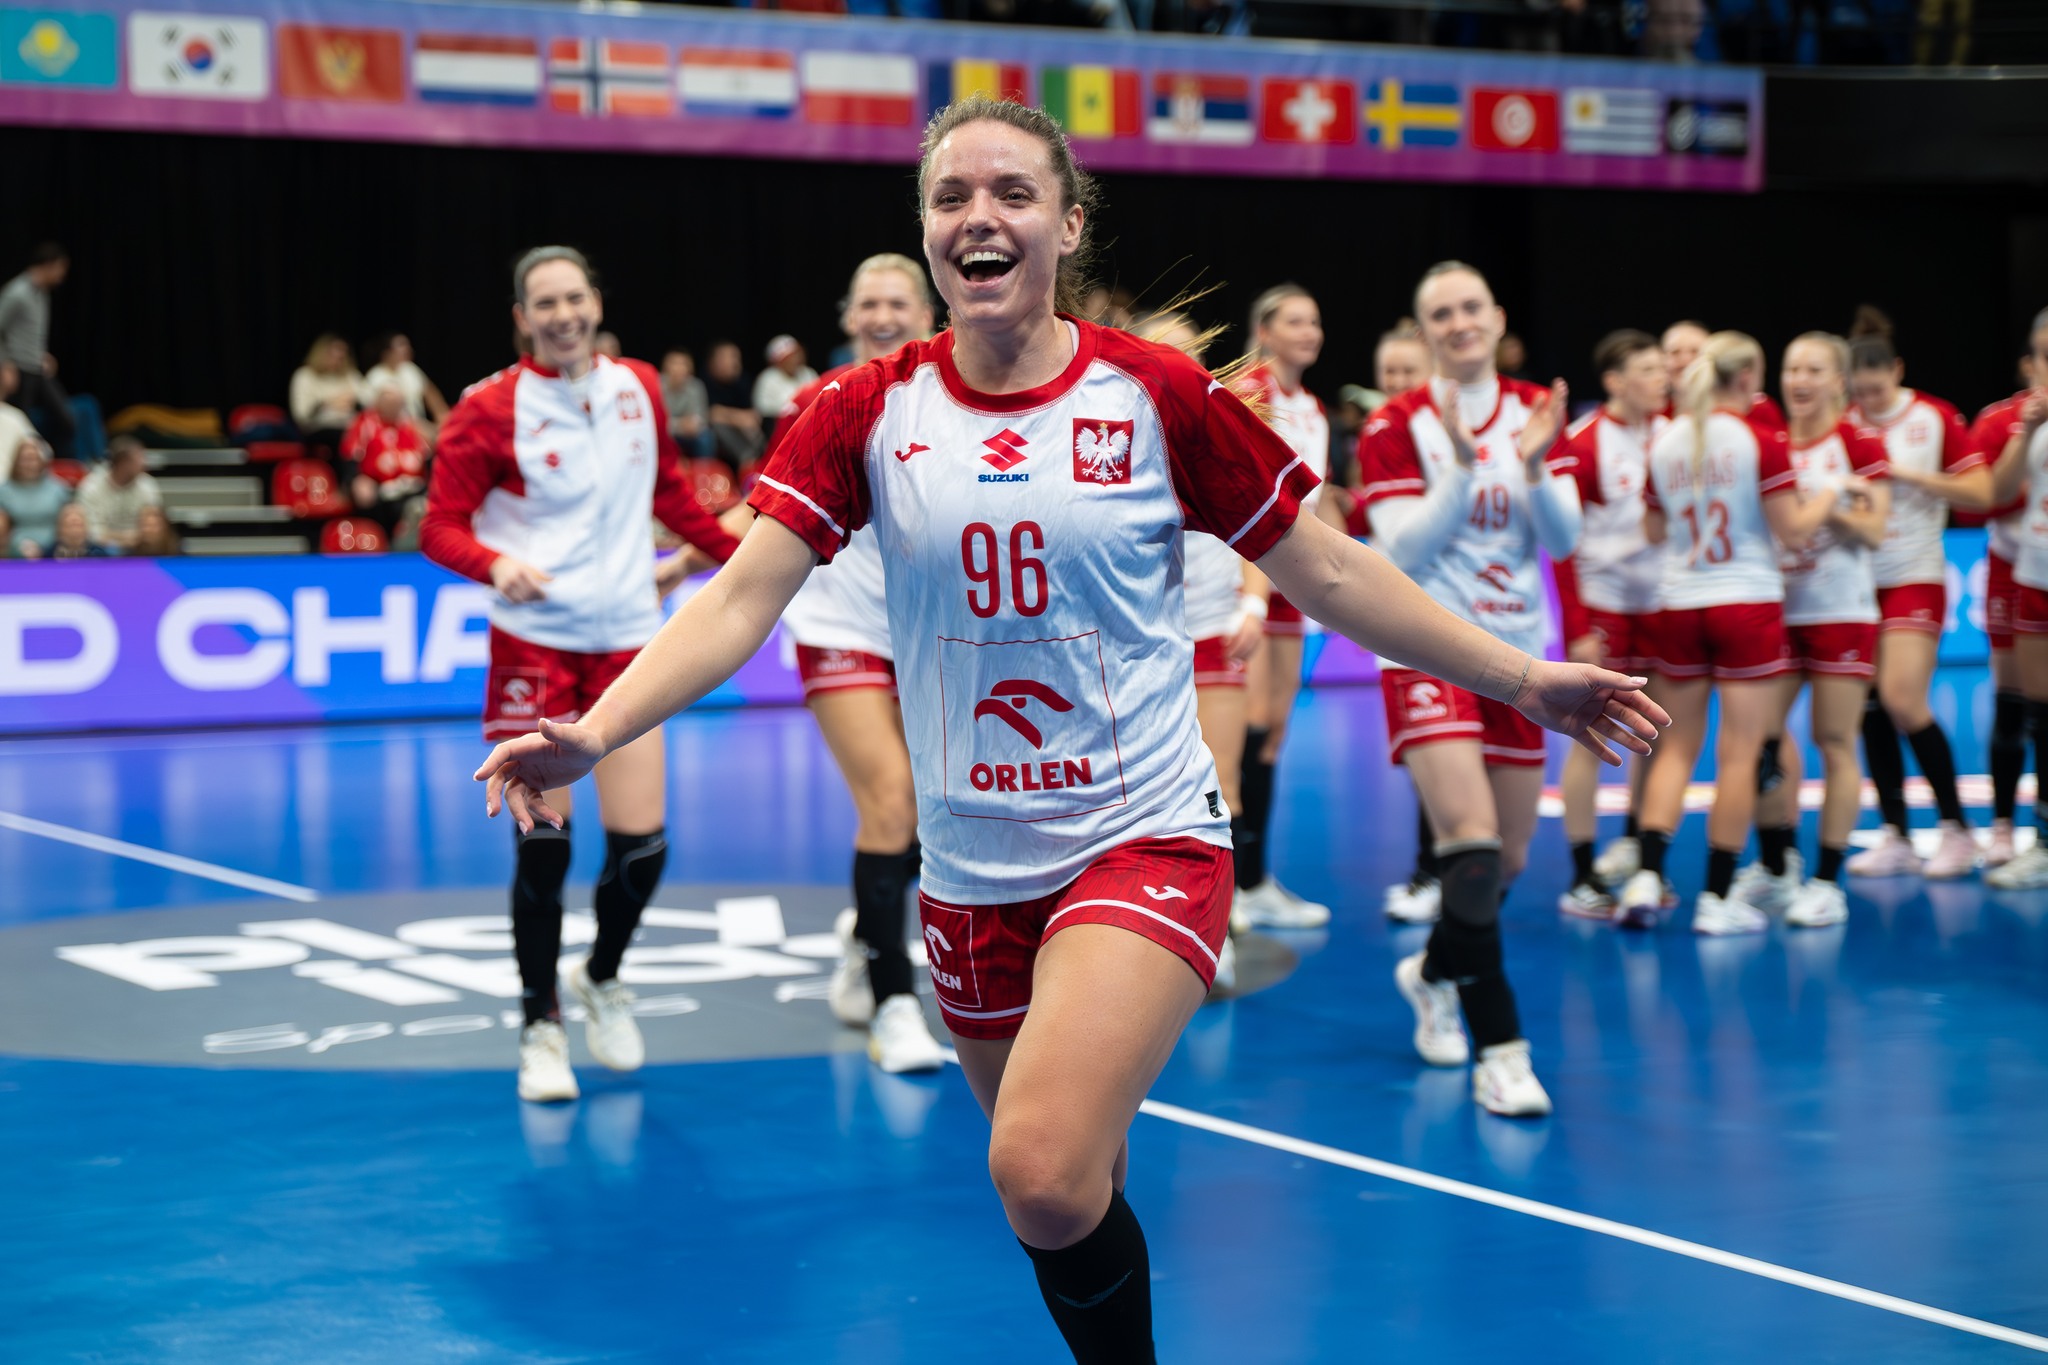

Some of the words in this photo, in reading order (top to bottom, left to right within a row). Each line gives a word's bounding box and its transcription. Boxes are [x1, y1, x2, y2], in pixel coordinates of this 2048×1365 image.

[977, 473, 1030, 483] SUZUKI
[1469, 484, 1510, 533] 49
[1680, 499, 1733, 567] 13
[961, 520, 1049, 618] 96
[0, 592, 120, 697] D
[969, 757, 1093, 792] ORLEN
[928, 958, 962, 991] RLEN
